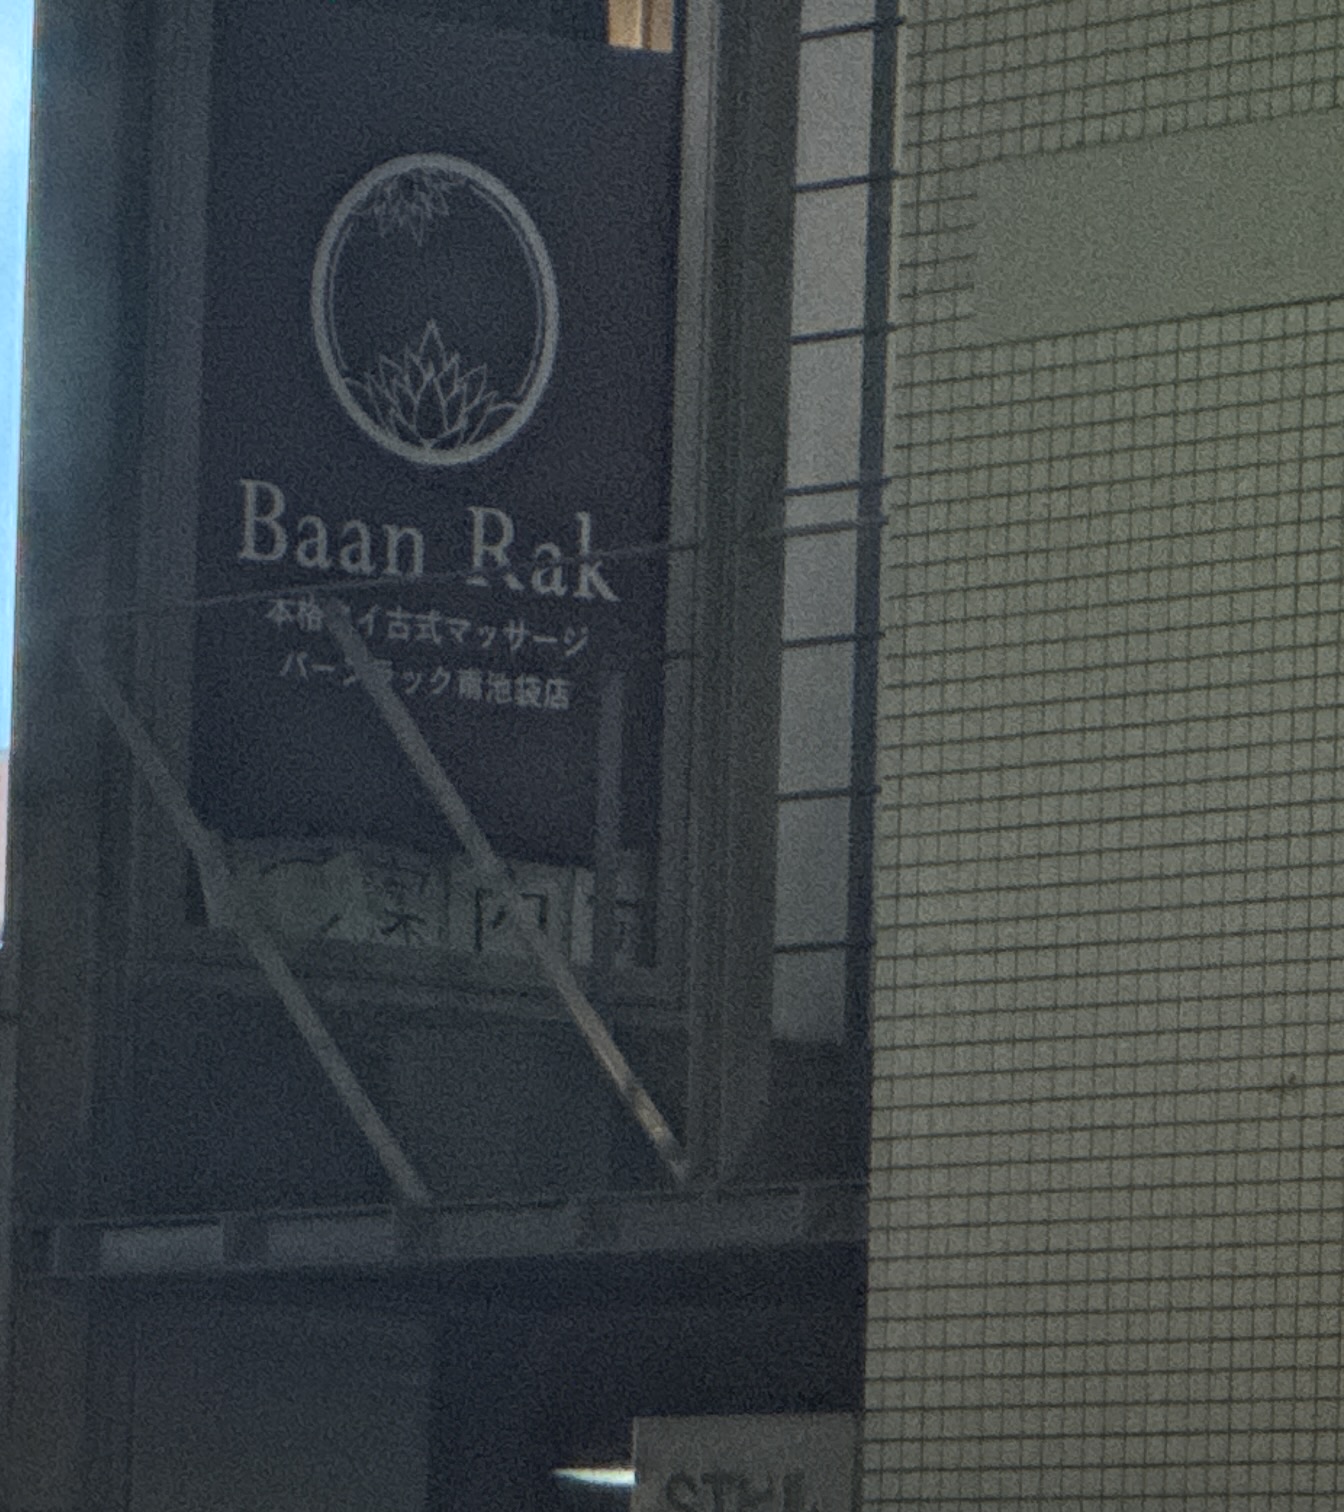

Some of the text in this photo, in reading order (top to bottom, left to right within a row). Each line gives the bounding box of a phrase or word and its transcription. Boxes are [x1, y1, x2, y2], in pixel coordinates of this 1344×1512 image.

[238, 477, 621, 602] Baan Rak
[266, 599, 590, 658] 本格イ古式マッサージ
